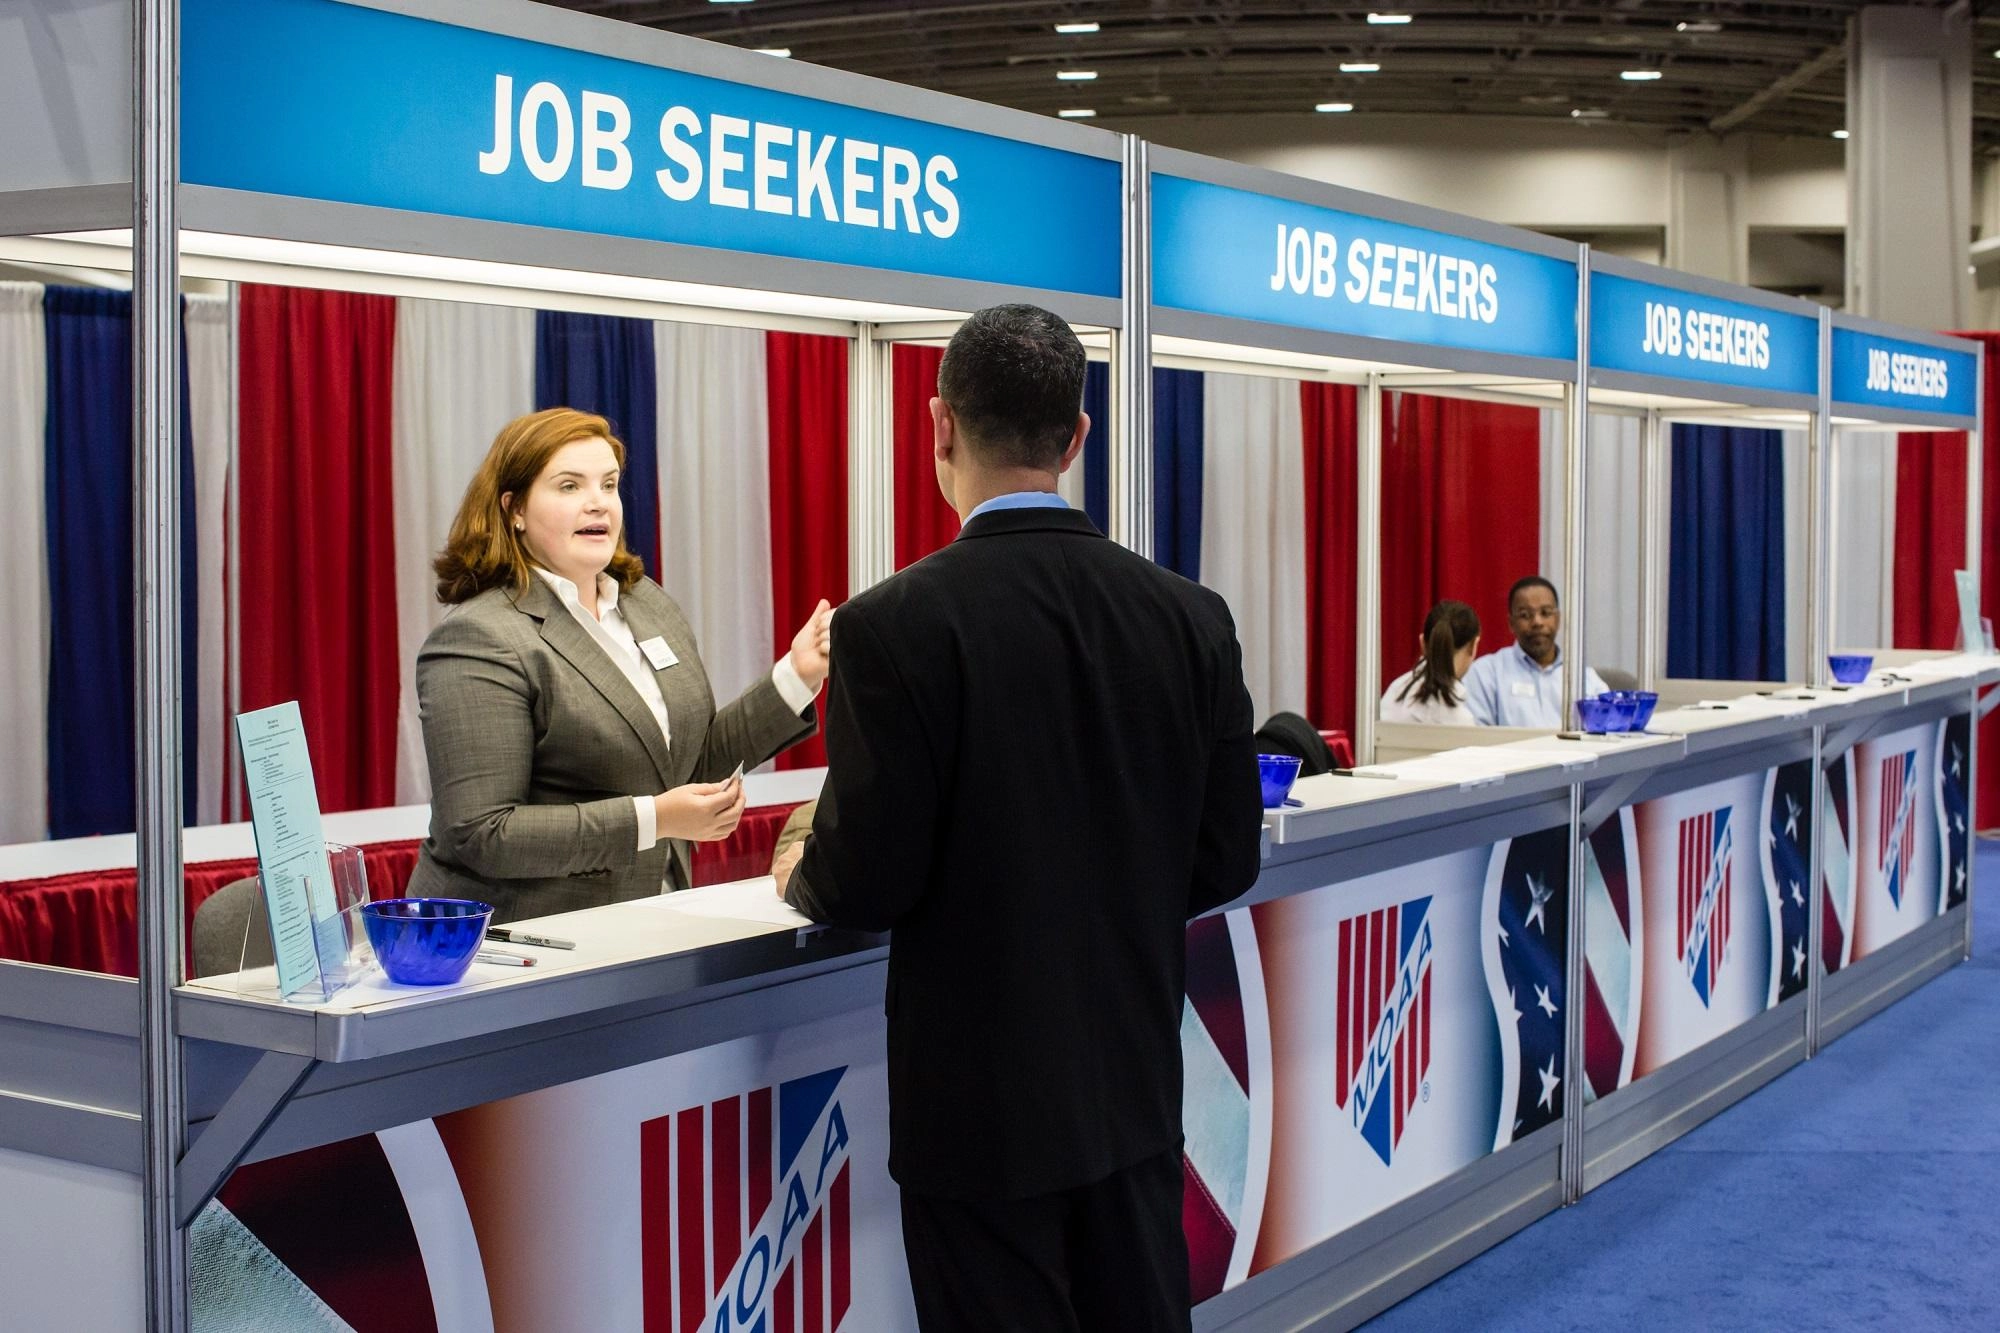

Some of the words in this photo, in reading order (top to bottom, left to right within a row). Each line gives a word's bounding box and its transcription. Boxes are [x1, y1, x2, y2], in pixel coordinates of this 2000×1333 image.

[478, 74, 633, 191] JOB
[655, 105, 960, 239] SEEKERS
[1269, 223, 1338, 299] JOB
[1344, 237, 1499, 325] SEEKERS
[1643, 302, 1683, 357] JOB
[1686, 309, 1770, 370] SEEKERS
[1866, 348, 1891, 391] JOB
[1892, 352, 1948, 398] SEEKERS
[1354, 919, 1432, 1128] MOAA
